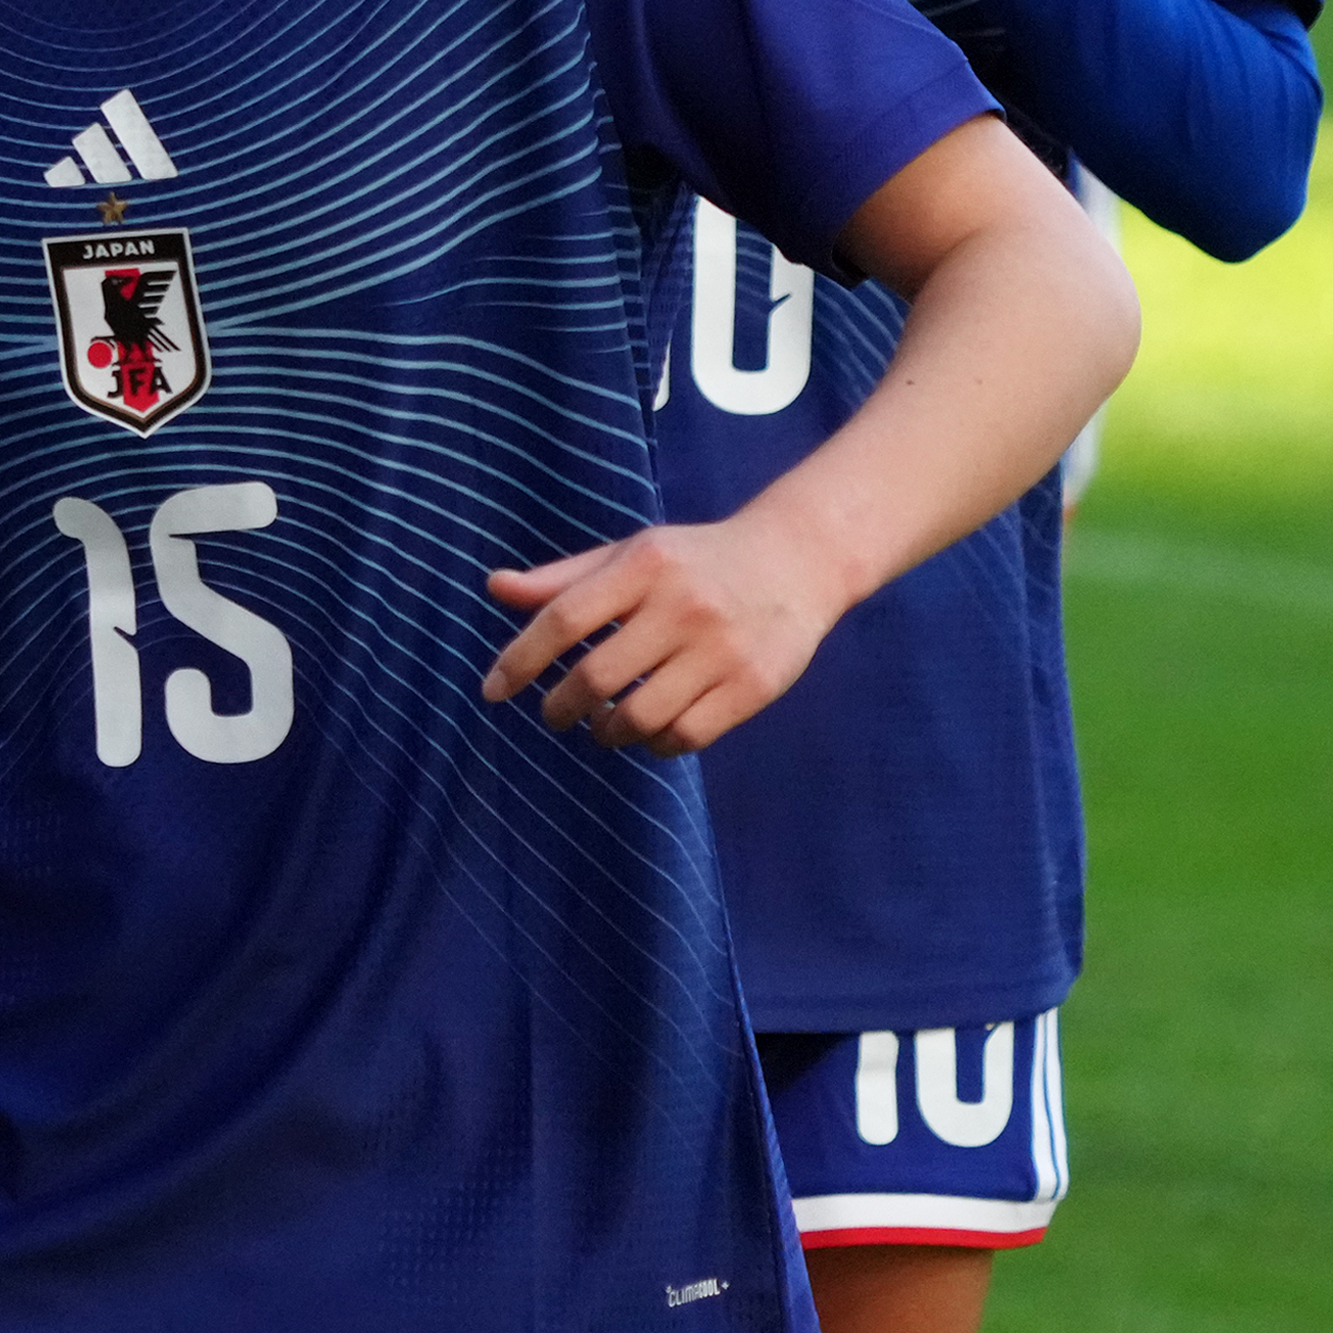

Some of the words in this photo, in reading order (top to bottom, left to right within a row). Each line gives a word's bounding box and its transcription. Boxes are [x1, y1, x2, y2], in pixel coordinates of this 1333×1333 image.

[83, 239, 156, 260] JAPAN
[107, 366, 173, 399] JFA
[52, 480, 295, 768] 15
